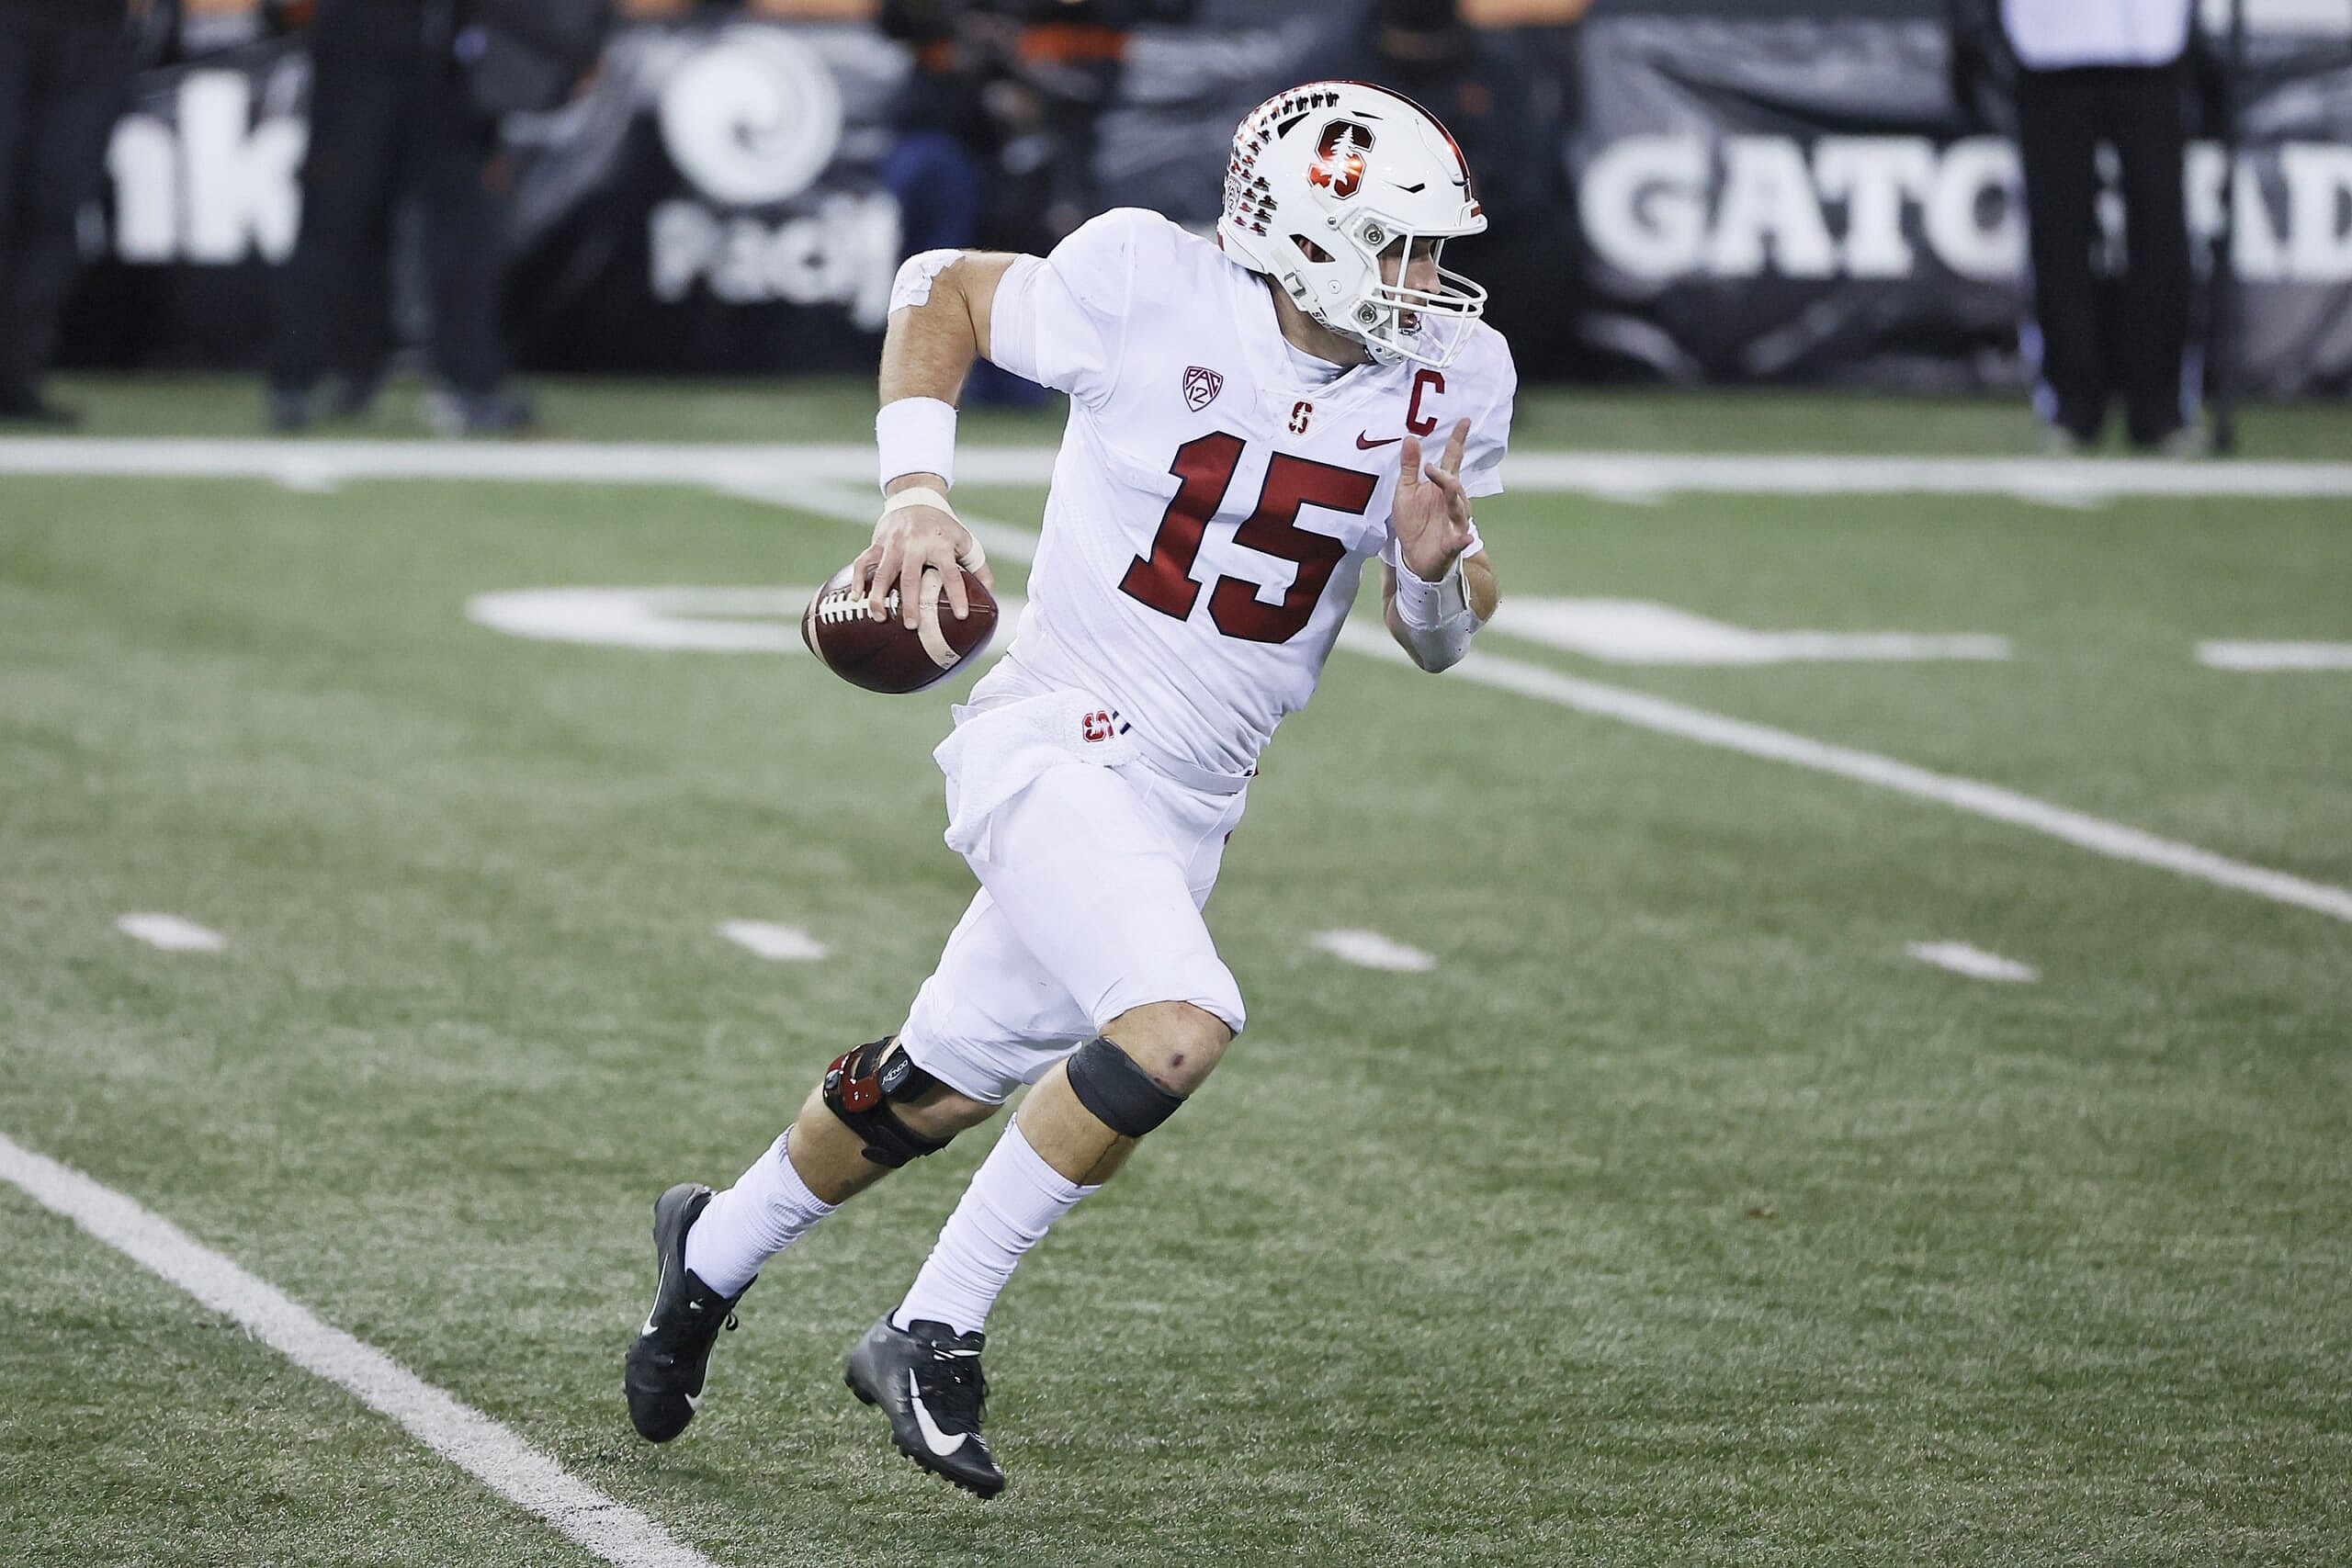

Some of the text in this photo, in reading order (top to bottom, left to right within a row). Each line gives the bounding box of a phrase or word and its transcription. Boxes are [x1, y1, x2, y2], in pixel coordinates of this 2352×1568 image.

[1578, 134, 2352, 280] GATOAD
[1185, 368, 1221, 398] PAC
[1189, 386, 1208, 404] 12
[1406, 368, 1445, 437] C
[1117, 430, 1380, 644] 15
